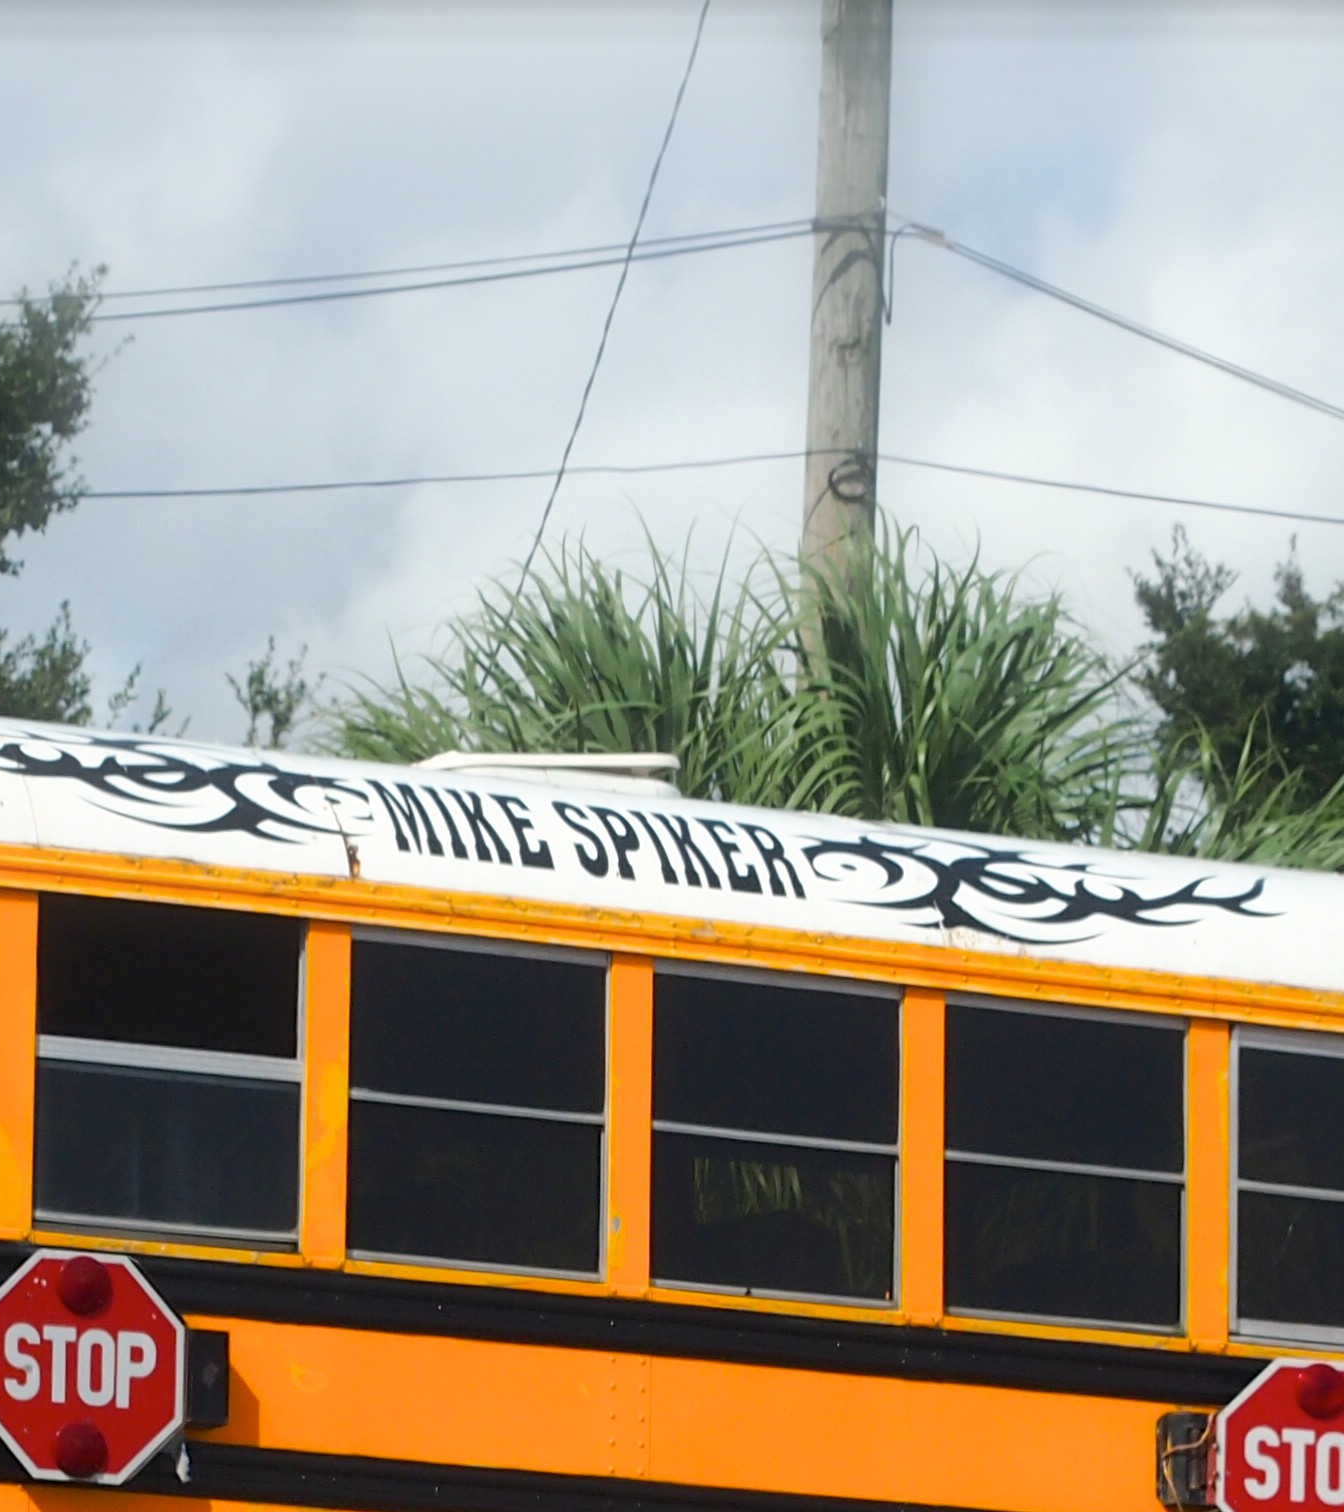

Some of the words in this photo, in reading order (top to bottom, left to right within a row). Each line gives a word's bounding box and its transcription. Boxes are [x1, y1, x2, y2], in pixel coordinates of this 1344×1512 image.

[366, 778, 554, 871] MIKE
[552, 800, 807, 900] SPIKER
[3, 1322, 157, 1410] STOP
